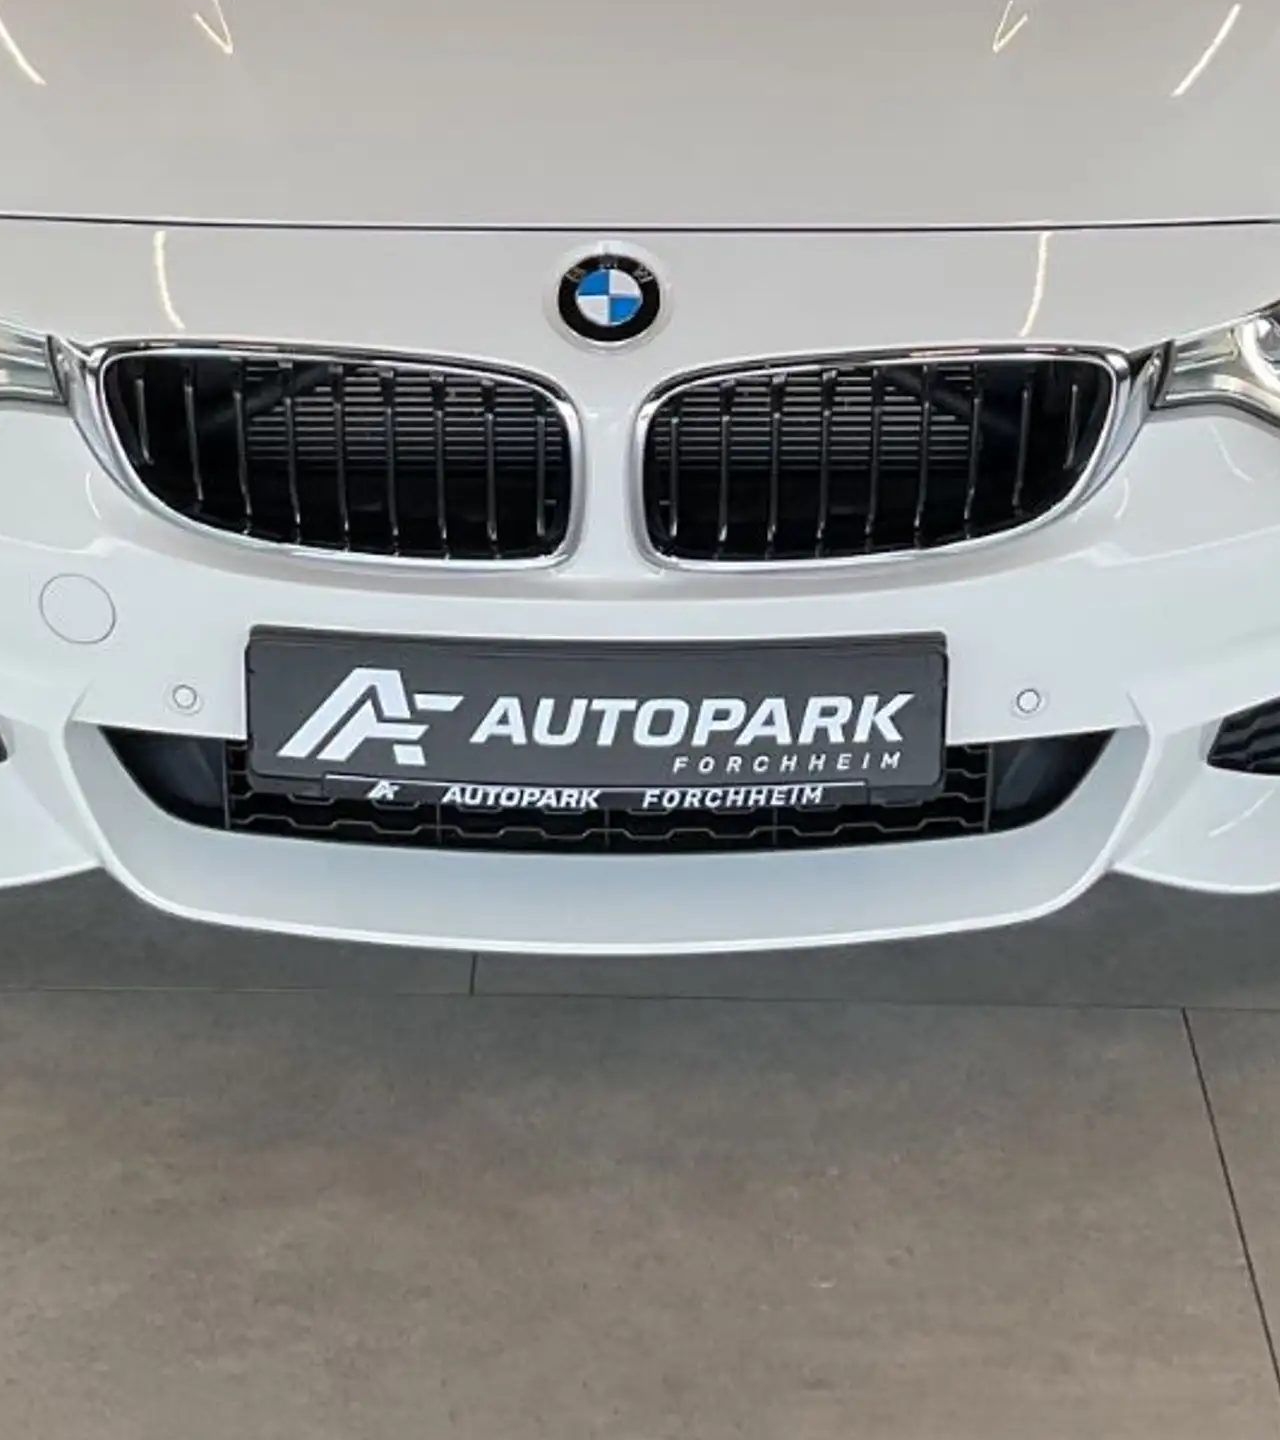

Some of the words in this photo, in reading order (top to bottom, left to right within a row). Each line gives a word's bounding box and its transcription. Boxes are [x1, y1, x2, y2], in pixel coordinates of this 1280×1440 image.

[469, 693, 915, 747] AUTOPARK
[672, 751, 901, 775] FORCHHEIM
[442, 784, 599, 808] AUTOPARK
[642, 786, 823, 809] FORCHHEIM
